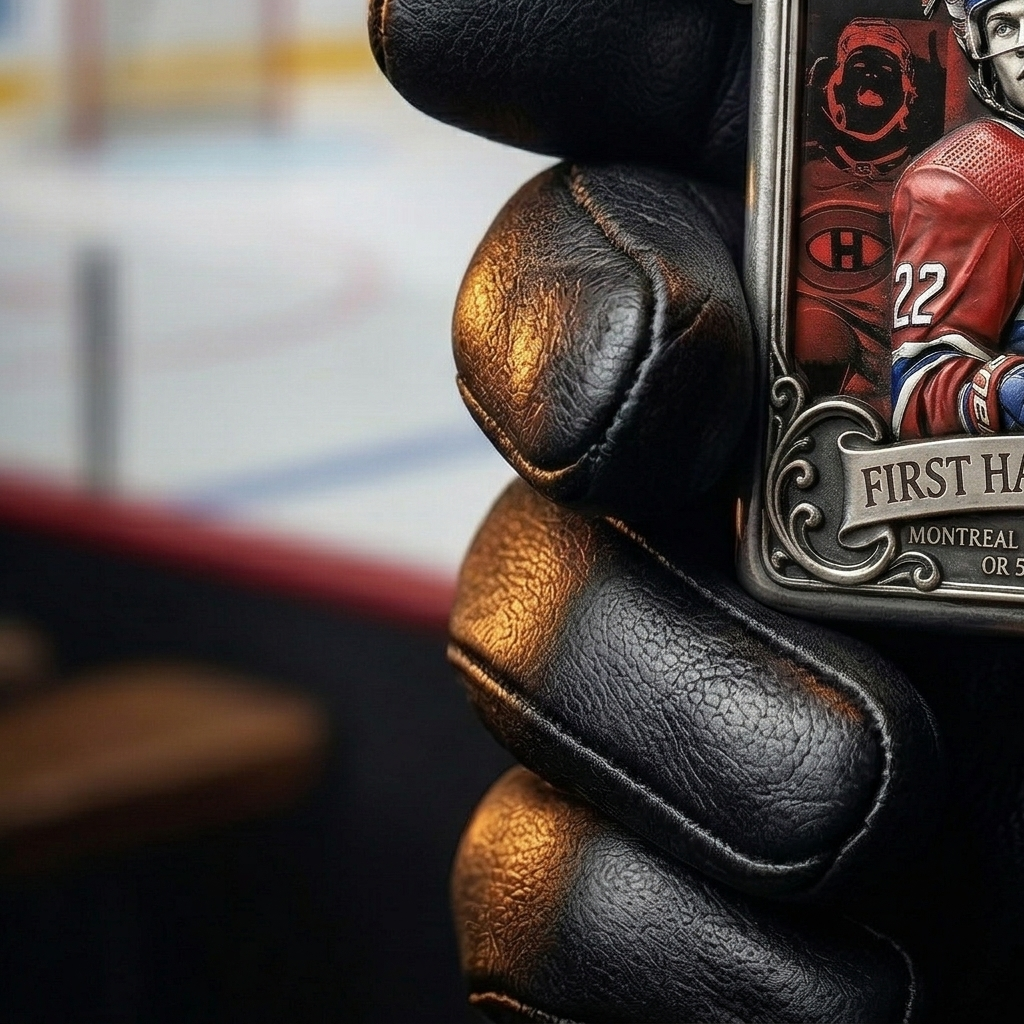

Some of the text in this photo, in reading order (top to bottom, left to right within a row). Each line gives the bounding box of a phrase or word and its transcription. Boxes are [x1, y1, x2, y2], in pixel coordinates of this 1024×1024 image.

[891, 261, 948, 330] 22
[860, 455, 972, 509] FIRST
[908, 526, 1019, 550] MONTREAL
[981, 555, 1010, 576] OR
